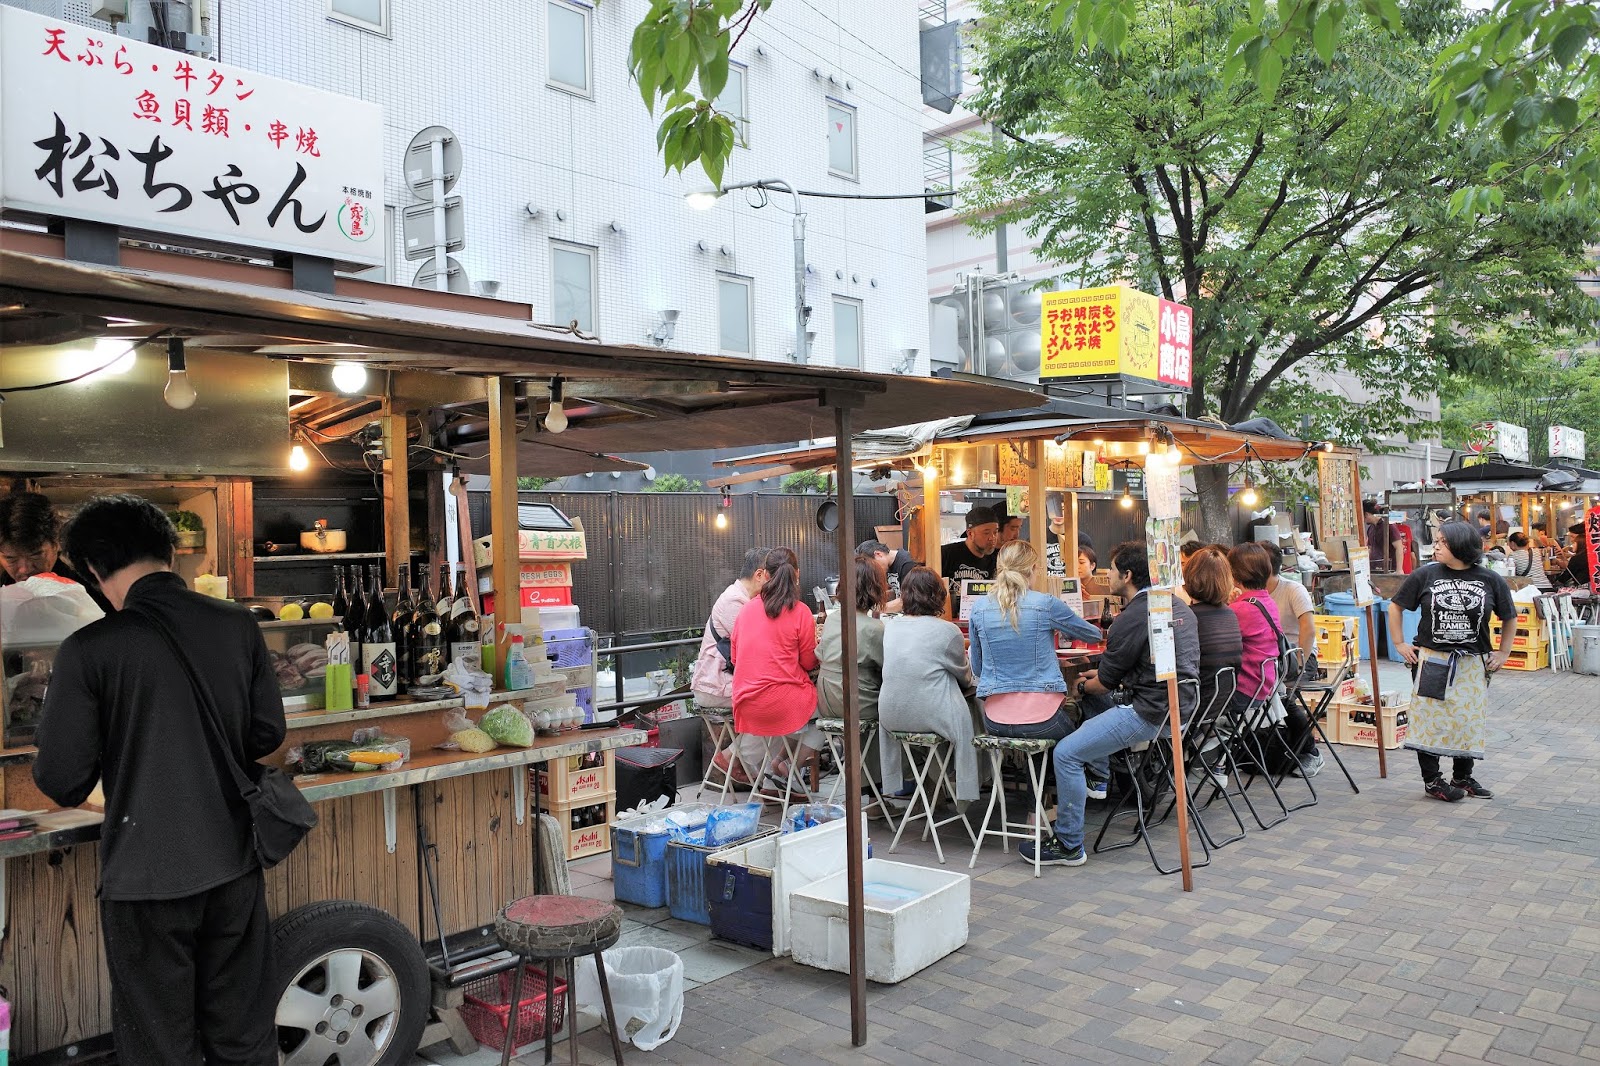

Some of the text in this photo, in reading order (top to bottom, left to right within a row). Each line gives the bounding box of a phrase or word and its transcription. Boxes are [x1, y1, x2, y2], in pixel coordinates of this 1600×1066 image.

[42, 28, 255, 101] 天ぷら・牛タン
[133, 89, 320, 158] 魚貝類・串焼
[33, 111, 327, 234] 松ちゃん
[1060, 308, 1073, 351] おでん
[1074, 306, 1087, 351] 明太子
[1088, 305, 1101, 350] 炭火焼
[1102, 304, 1116, 332] もつ
[1046, 309, 1060, 361] ラーメン
[1552, 426, 1561, 455] ラーメン
[529, 533, 583, 550] 青首大根
[520, 570, 563, 580] RESH EGGS
[378, 655, 391, 683] 辛口
[571, 786, 577, 794] 中
[576, 773, 596, 785] Asahi
[573, 843, 579, 852] 中
[578, 831, 598, 844] Asahi
